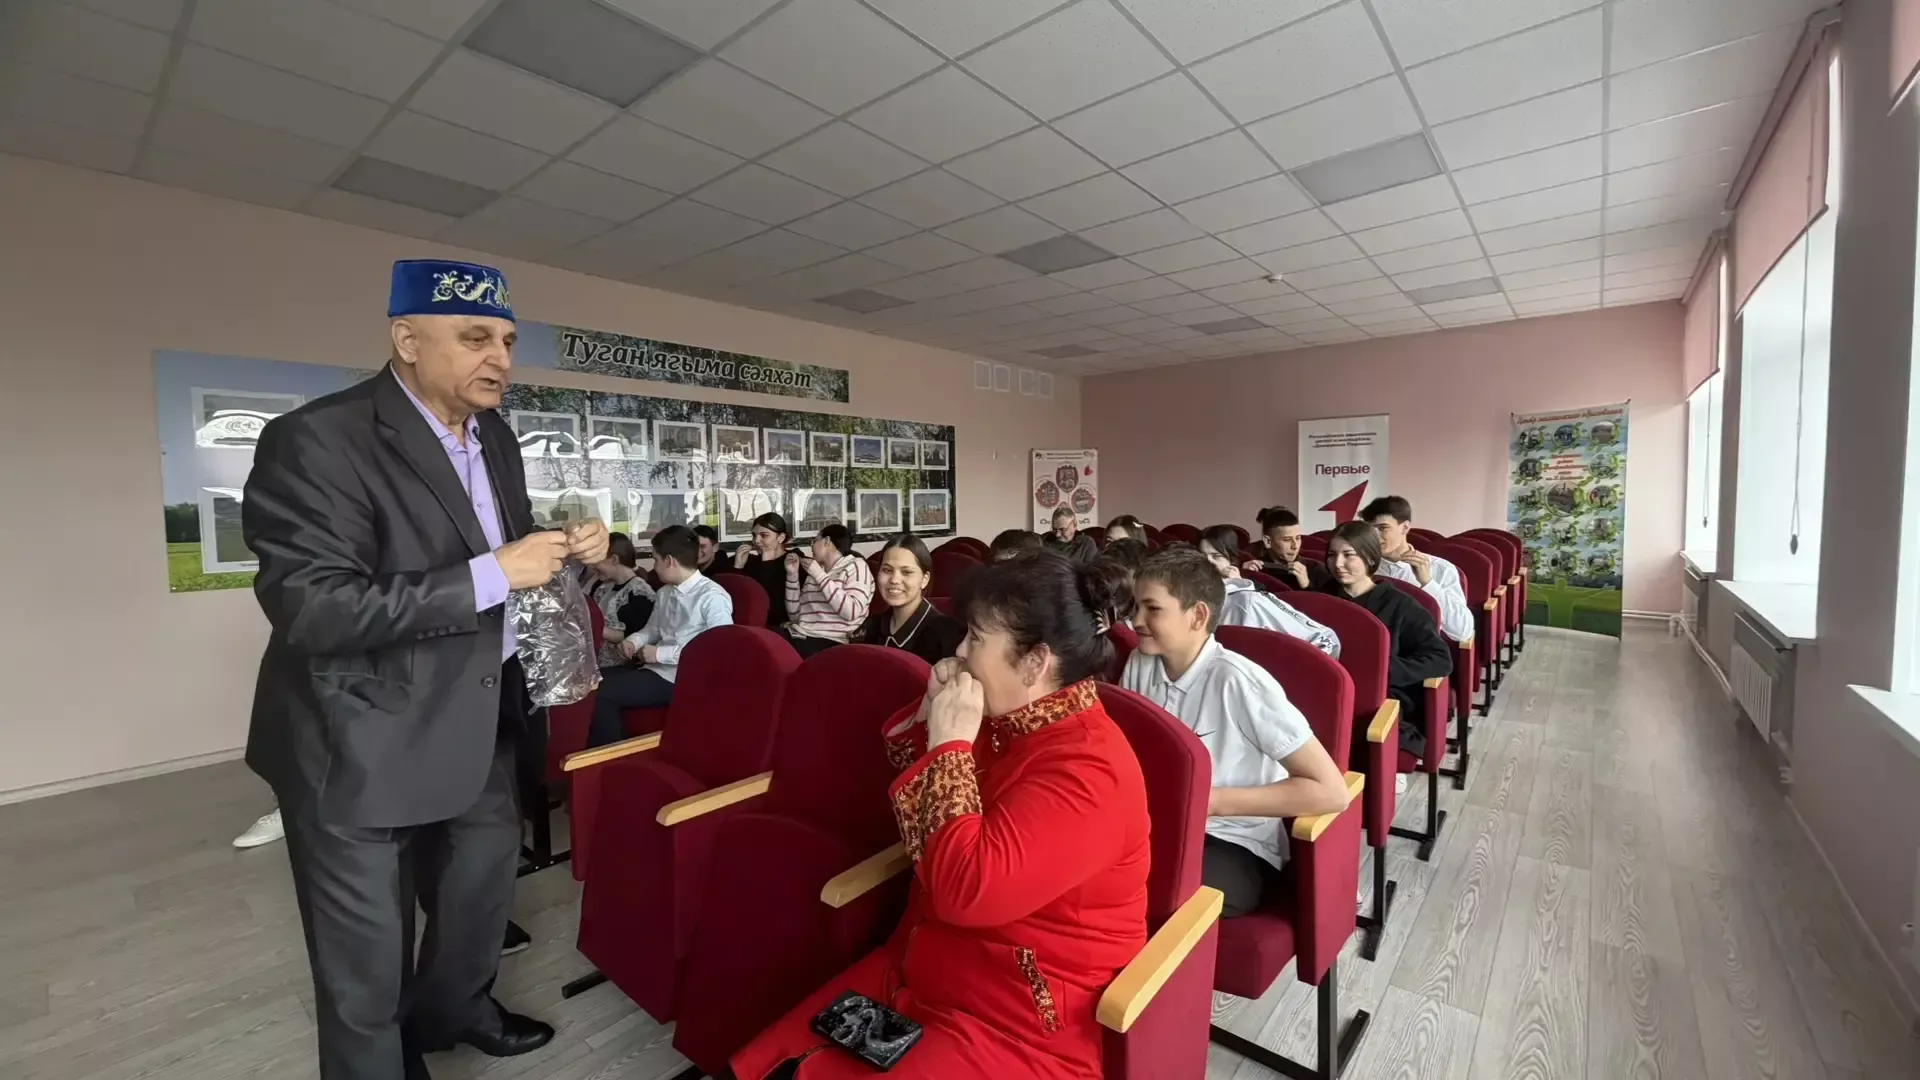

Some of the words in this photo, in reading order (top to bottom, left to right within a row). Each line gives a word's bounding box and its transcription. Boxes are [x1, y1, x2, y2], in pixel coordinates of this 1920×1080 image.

[563, 332, 645, 366] Туган
[650, 352, 735, 380] ягыма
[739, 366, 812, 388] сәяхәт
[1315, 463, 1371, 478] Первые
